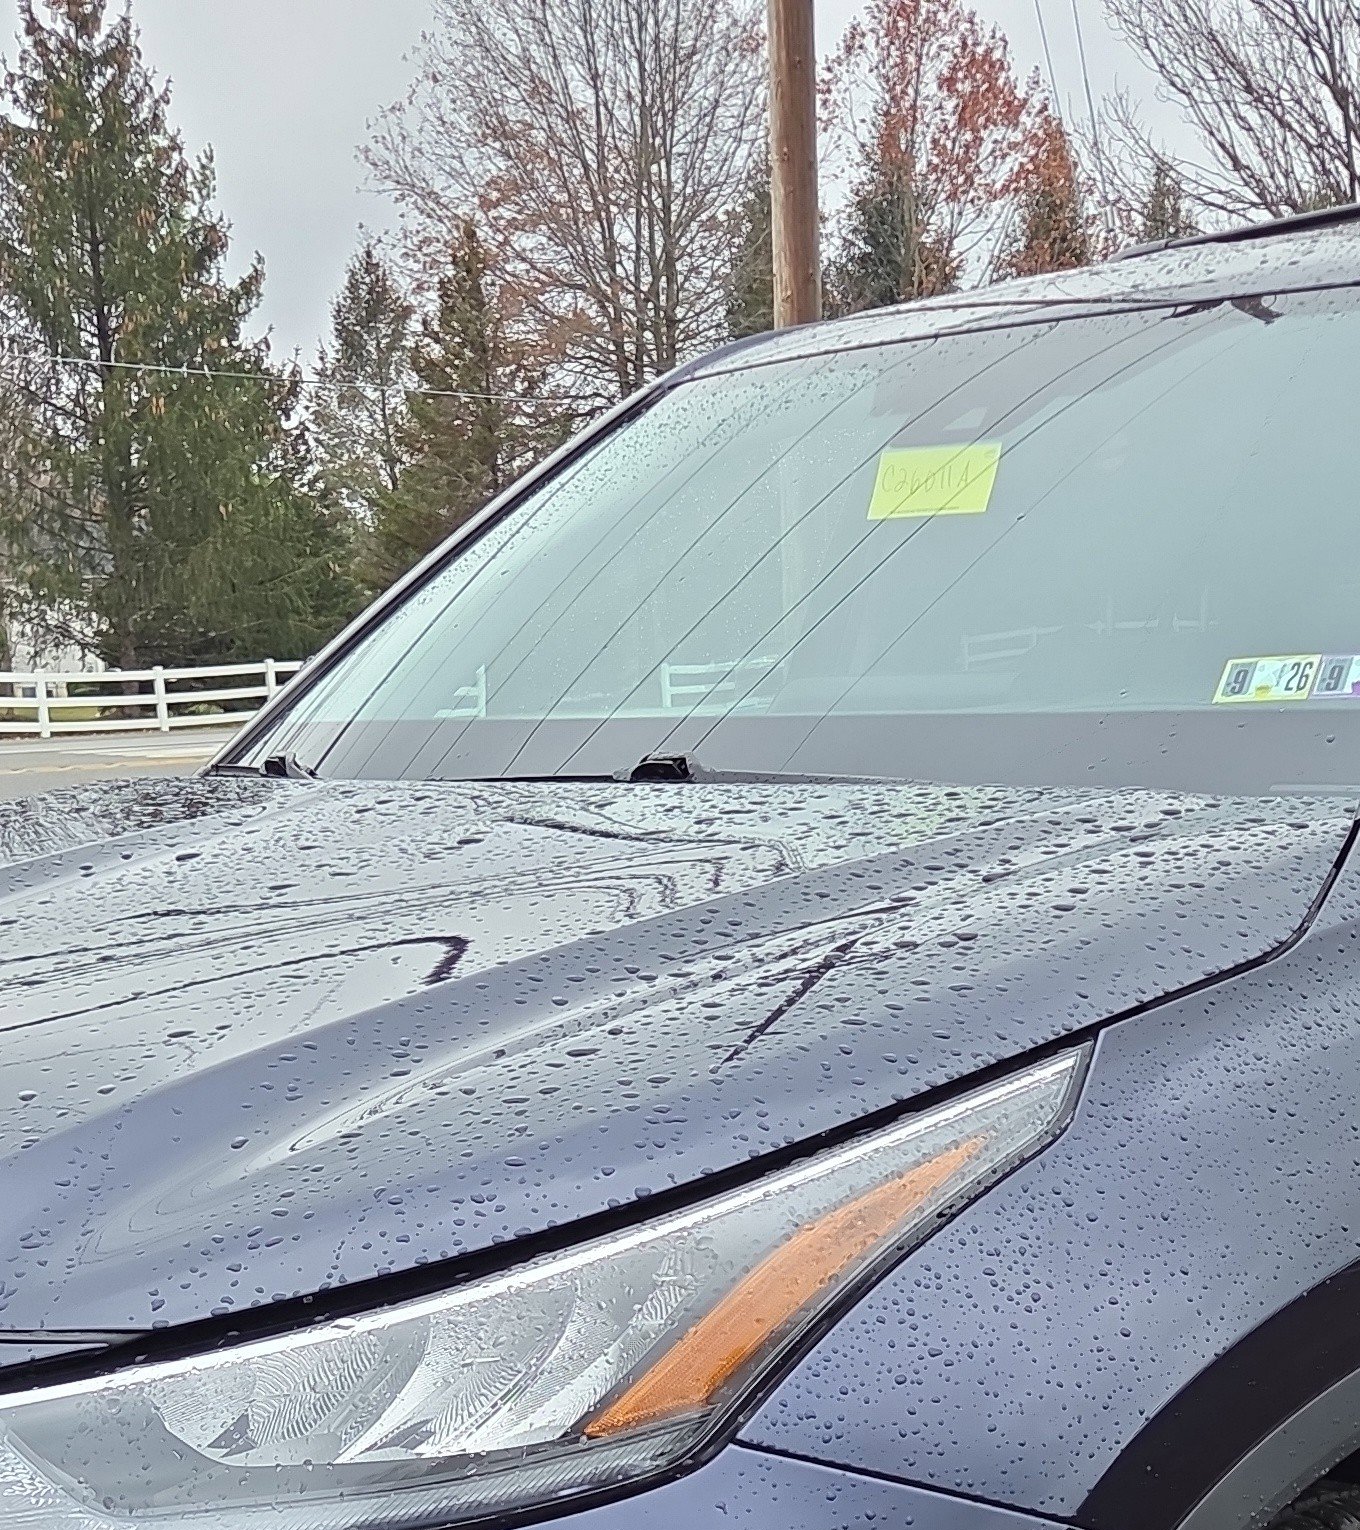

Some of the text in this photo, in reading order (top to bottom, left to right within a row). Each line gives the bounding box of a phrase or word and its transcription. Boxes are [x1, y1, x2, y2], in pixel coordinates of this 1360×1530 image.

[881, 459, 972, 493] C26011A
[1231, 668, 1249, 695] 9
[1284, 661, 1314, 694] 26
[1325, 664, 1344, 692] 9
